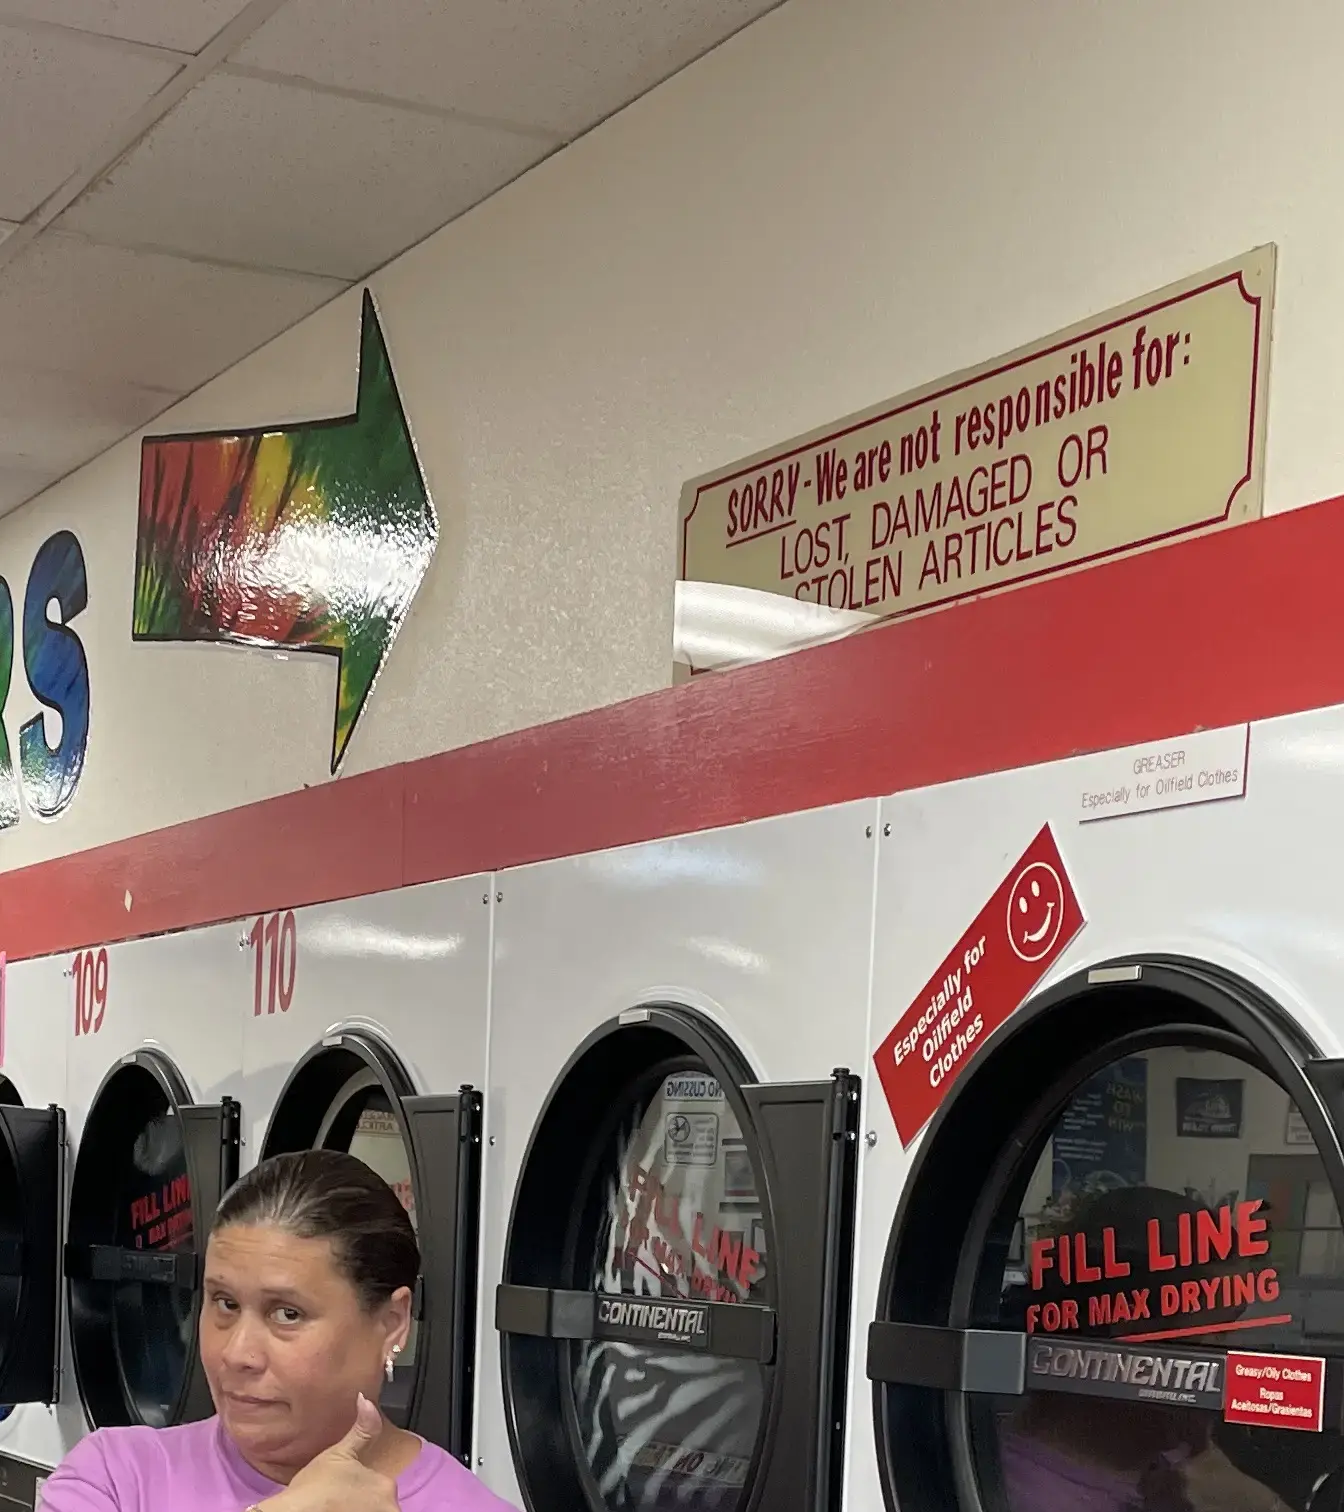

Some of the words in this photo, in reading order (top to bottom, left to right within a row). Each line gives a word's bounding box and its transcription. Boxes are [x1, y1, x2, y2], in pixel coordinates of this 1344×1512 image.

[853, 445, 892, 493] are
[898, 416, 942, 477] not
[953, 343, 1123, 452] responsible
[1131, 325, 1192, 391] for:
[780, 514, 851, 582] LOST,
[871, 454, 1032, 550] DAMAGED
[1057, 425, 1109, 490] OR
[918, 496, 1078, 592] ARTICLES
[1080, 782, 1132, 809] Especially
[1134, 781, 1152, 800] for
[1154, 772, 1195, 796] Oilfield
[1196, 765, 1240, 791] Clothes
[1131, 750, 1187, 777] GREASER
[72, 948, 109, 1037] 109
[250, 910, 297, 1018] 110
[893, 966, 968, 1068] Especially
[962, 934, 987, 983] for
[920, 991, 974, 1064] Oilfield
[927, 1014, 985, 1089] Clothes
[1030, 1226, 1131, 1291] FILL
[1146, 1199, 1270, 1272] LINE
[598, 1299, 707, 1336] CONTINENTAL
[1026, 1299, 1080, 1335] FOR
[1088, 1287, 1151, 1327] MAX
[1160, 1268, 1281, 1318] DRYING
[1031, 1345, 1222, 1393] CONTINENTAL
